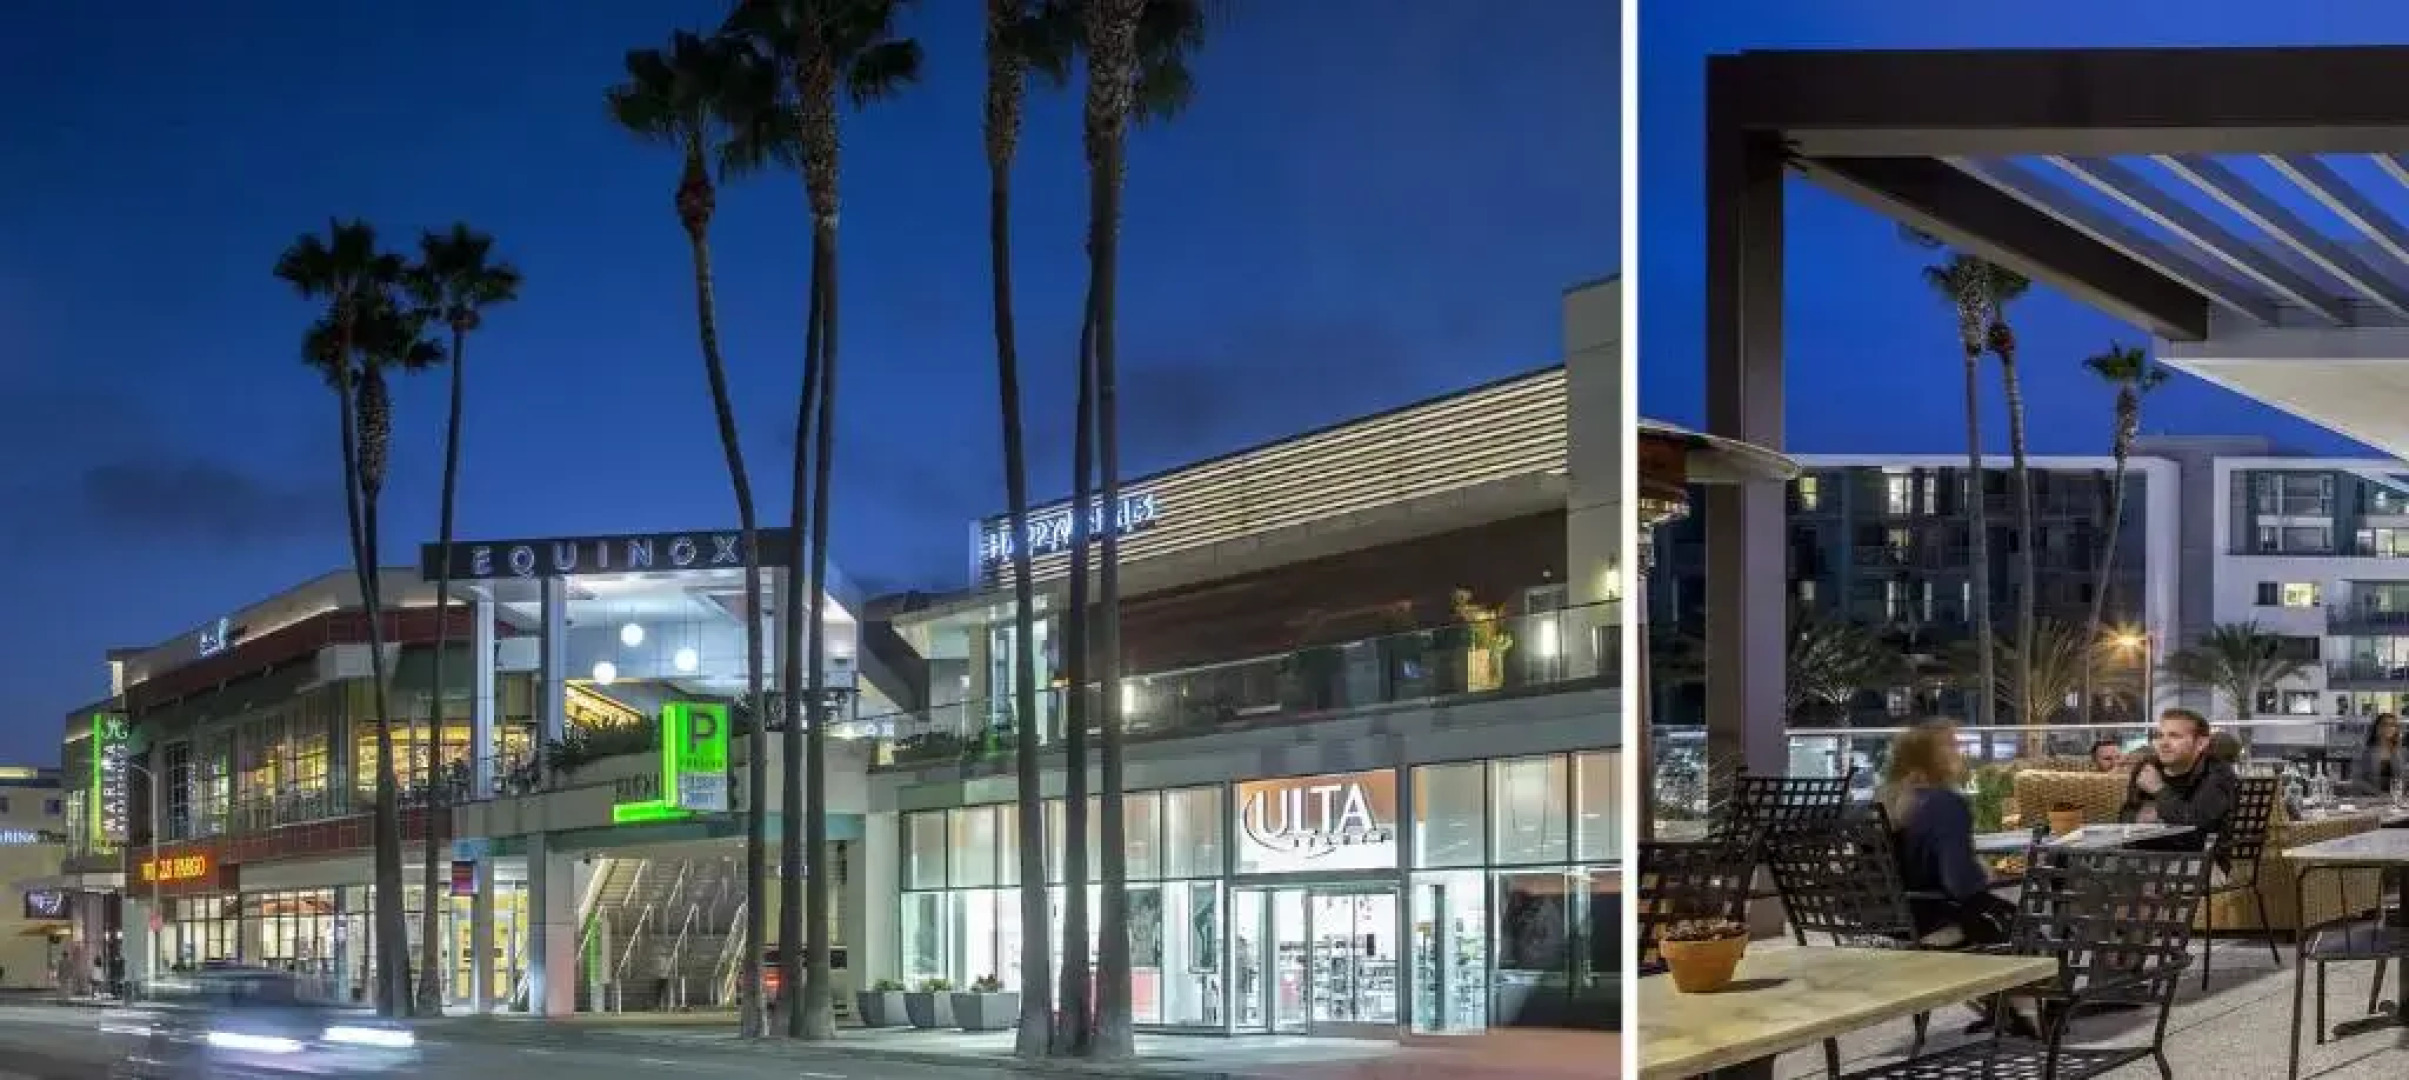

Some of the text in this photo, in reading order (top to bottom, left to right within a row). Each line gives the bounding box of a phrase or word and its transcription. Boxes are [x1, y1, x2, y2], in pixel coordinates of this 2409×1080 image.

[471, 534, 739, 578] EQUINOX
[687, 711, 718, 753] P
[102, 743, 116, 832] MARINA
[1254, 782, 1376, 836] ULTA
[141, 855, 206, 880] WELS FARGO
